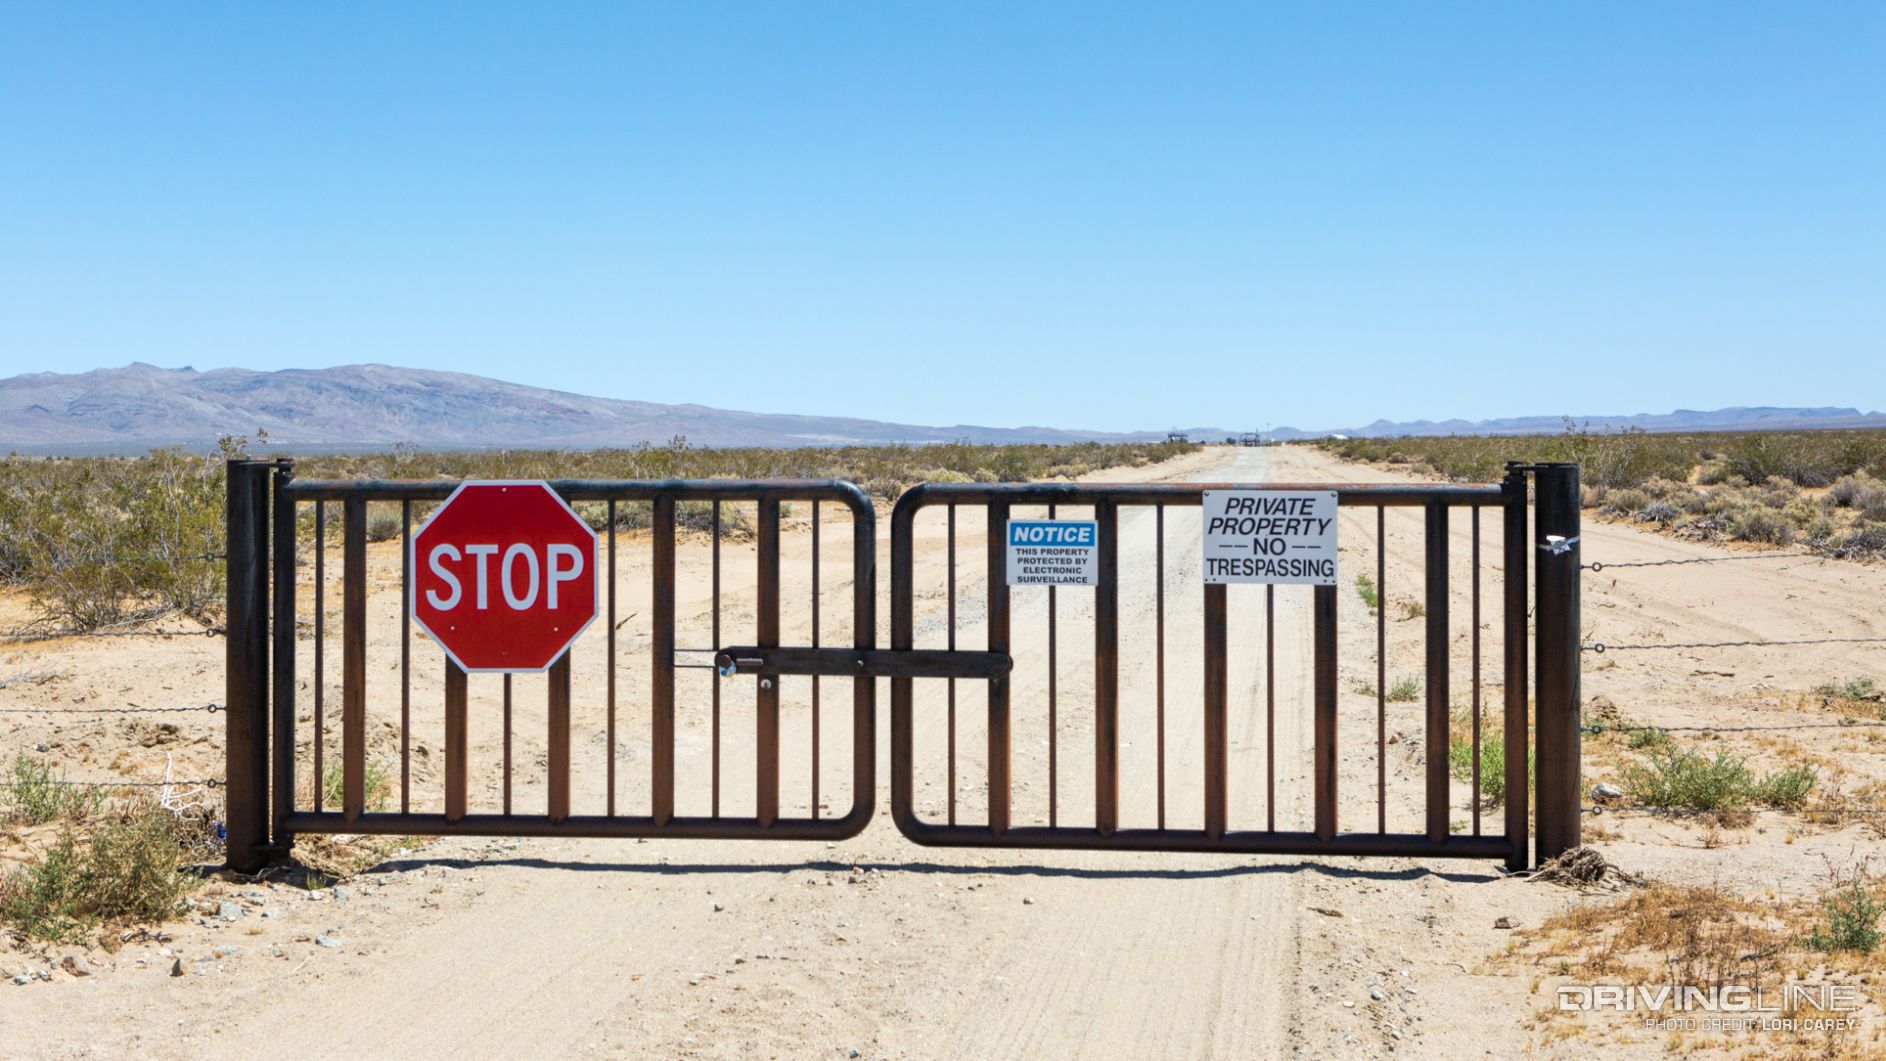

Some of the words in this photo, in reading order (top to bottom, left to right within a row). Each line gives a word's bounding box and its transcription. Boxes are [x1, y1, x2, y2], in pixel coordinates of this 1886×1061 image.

[1224, 497, 1316, 516] PRIVATE
[1013, 526, 1092, 542] NOTICE
[1207, 517, 1332, 536] PROPERTY
[1040, 548, 1089, 556] PROPERTY
[1253, 538, 1286, 556] NO
[1017, 557, 1073, 565] PROTECTED
[1206, 558, 1334, 577] TRESPASSING
[425, 543, 585, 611] STOP
[1017, 576, 1088, 584] SURVEILLANCE
